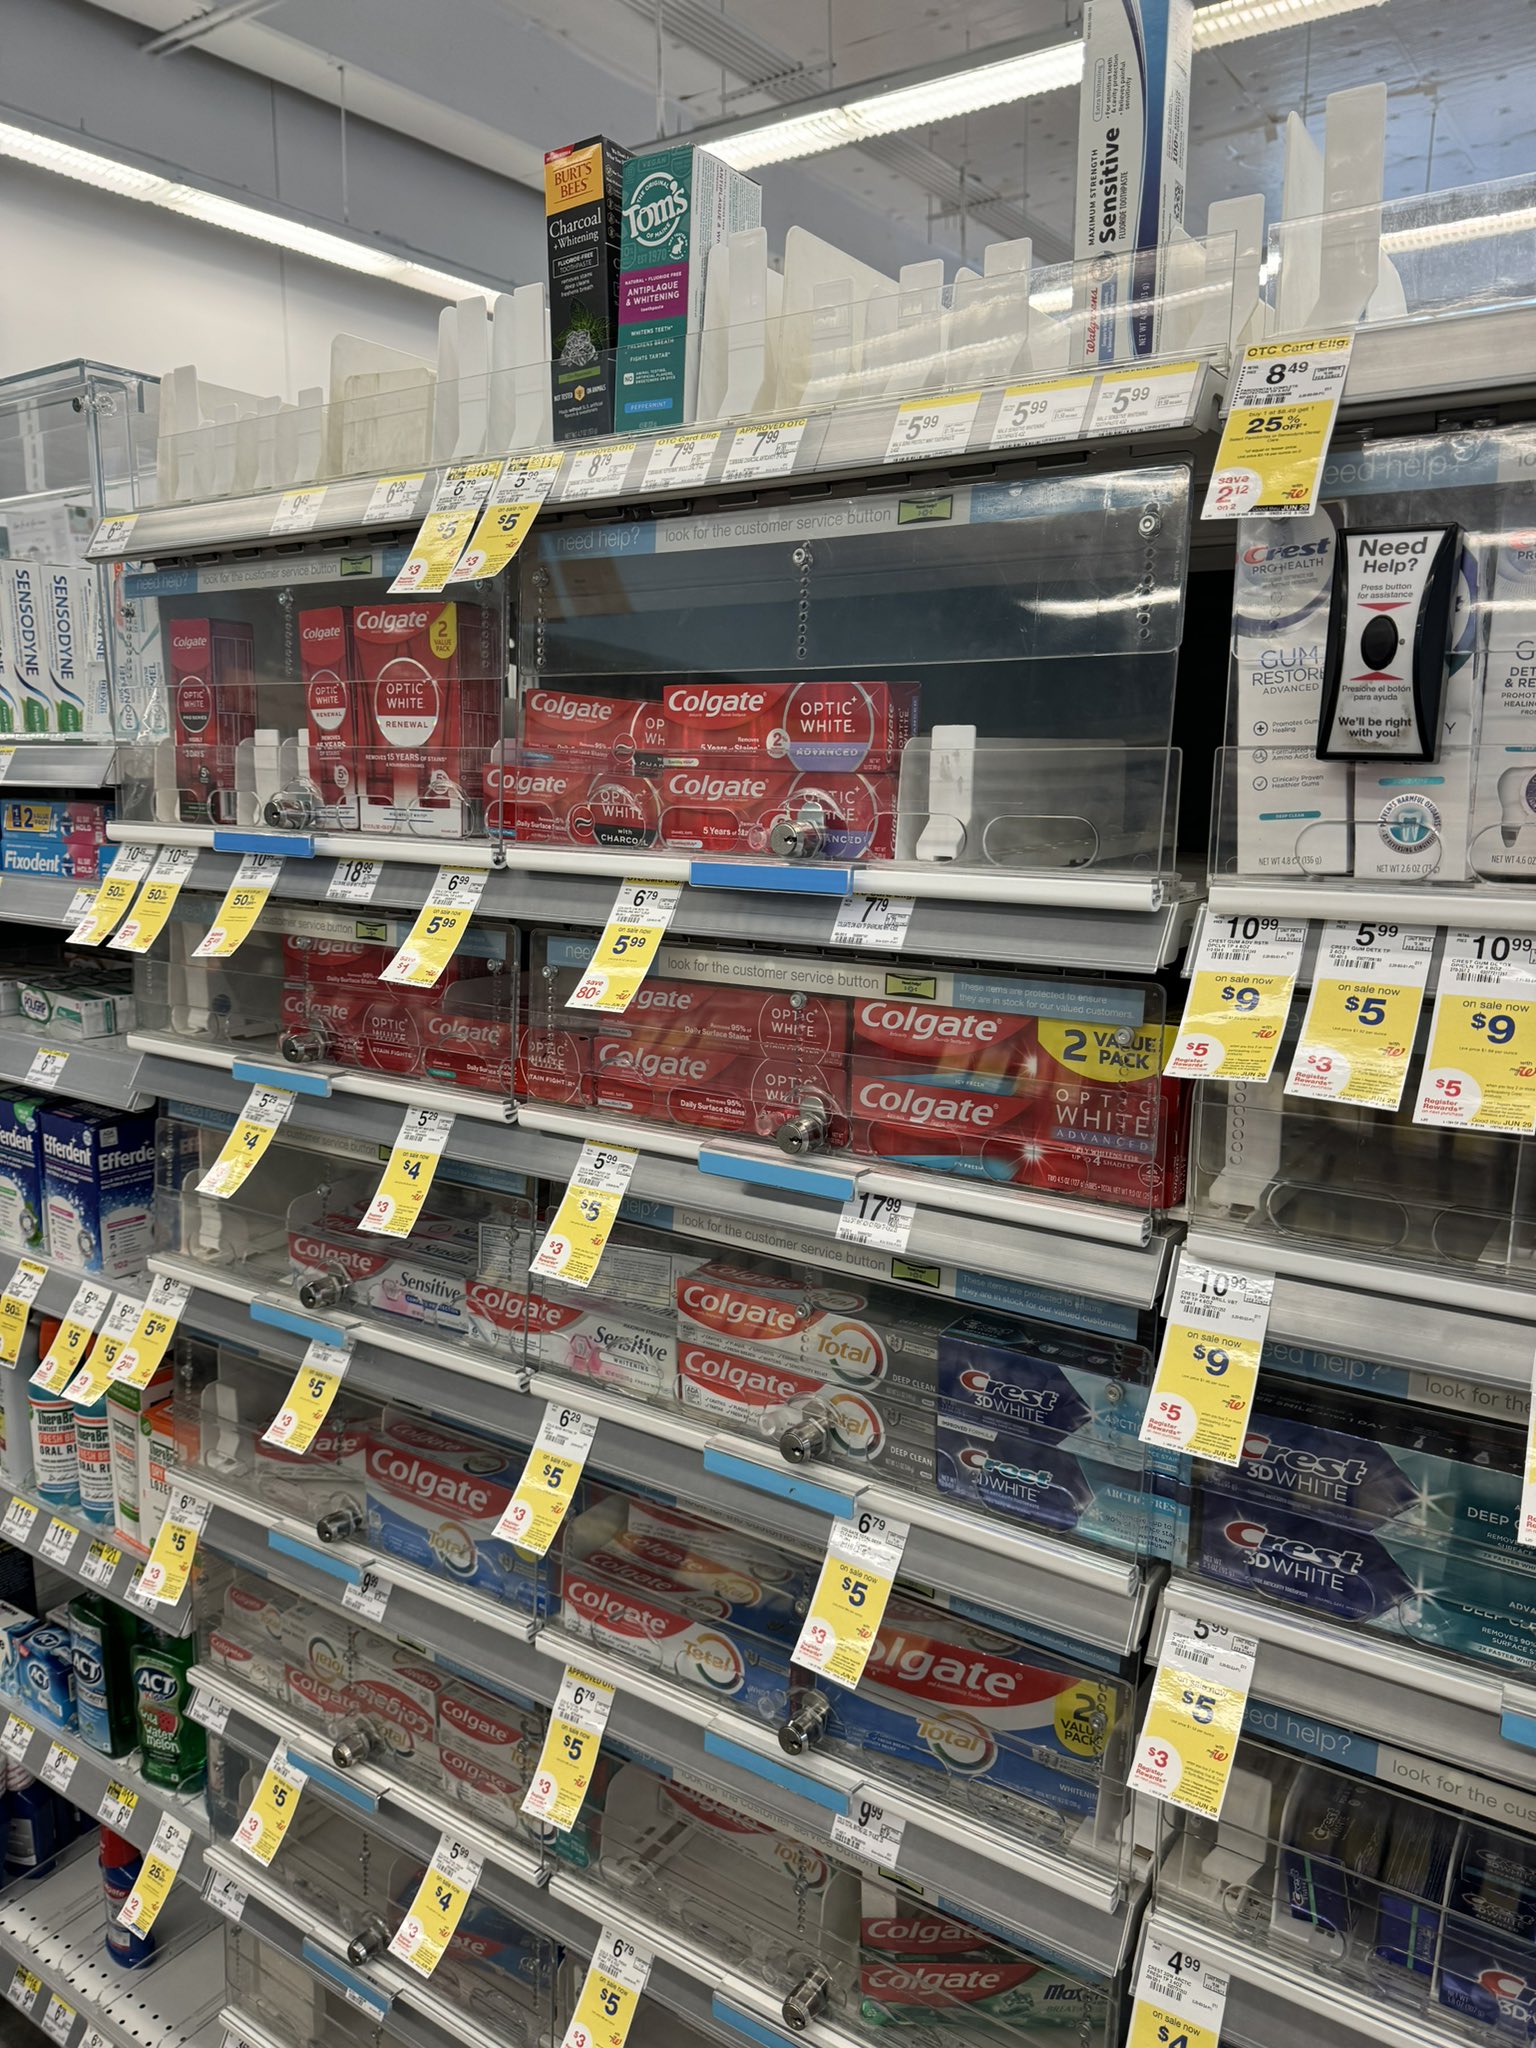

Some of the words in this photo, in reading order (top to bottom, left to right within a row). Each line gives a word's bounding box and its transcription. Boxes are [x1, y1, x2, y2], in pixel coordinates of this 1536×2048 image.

[555, 161, 592, 186] BURT'S
[1099, 127, 1120, 243] Sensitive
[561, 178, 587, 198] BEES
[637, 190, 645, 203] THE
[645, 180, 669, 190] ORIGINAL
[549, 207, 602, 238] Charcoal
[654, 222, 670, 238] MAINE
[1119, 208, 1127, 240] FLUORIDE
[560, 260, 592, 273] TOOTHPASTE
[648, 273, 669, 281] FLUORIDE
[628, 281, 678, 296] ANTIPLAQUE
[634, 291, 679, 304] WHITENING
[1247, 347, 1278, 357] OTC
[1281, 343, 1314, 354] Card
[631, 401, 666, 410] PEPPERMINT
[1218, 476, 1249, 484] save
[665, 529, 690, 542] look
[693, 528, 707, 540] for
[712, 526, 731, 538] the
[734, 519, 792, 538] customer
[796, 514, 843, 531] service
[847, 508, 891, 525] button
[557, 531, 593, 551] need
[598, 526, 640, 550] help?
[1359, 536, 1428, 557] Need
[1243, 538, 1331, 564] Crest
[1363, 558, 1418, 574] Help?
[1357, 591, 1369, 599] for
[1370, 591, 1413, 599] assistance
[1383, 583, 1412, 591] button
[16, 568, 40, 677] SENSODYNE
[53, 574, 74, 680] SENSODYNE
[303, 626, 340, 640] Colgate
[356, 611, 428, 632] Colgate
[437, 620, 448, 638] 2
[173, 636, 207, 648] Colgate
[1261, 646, 1318, 669] GUM
[316, 687, 337, 695] OPTIC
[316, 695, 339, 704] WHITE
[386, 682, 423, 695] OPTIC
[1262, 683, 1319, 695] ADVANCED
[1354, 693, 1371, 701] para
[1373, 693, 1398, 701] ayuda
[387, 698, 424, 709] WHITE
[531, 693, 612, 721] Colgate
[668, 690, 766, 718] Colgate
[800, 701, 852, 715] OPTIC
[1272, 719, 1303, 727] Promotes
[1338, 717, 1366, 726] We'll
[1369, 717, 1382, 726] be
[1385, 717, 1412, 728] right
[1349, 728, 1371, 738] with
[1374, 729, 1400, 738] you!
[669, 774, 768, 802] Colgate
[1272, 781, 1298, 789] Healthier
[4, 850, 59, 874] Fixodent
[1376, 865, 1387, 873] NET
[1389, 865, 1398, 873] WT
[1401, 865, 1411, 873] 2.6
[667, 957, 689, 970] look
[692, 959, 704, 972] for
[709, 962, 729, 974] the
[732, 965, 787, 981] customer
[791, 969, 833, 984] service
[838, 973, 879, 989] button
[959, 983, 984, 992] These
[986, 985, 1007, 995] items
[1009, 988, 1023, 996] are
[1024, 989, 1065, 1001] protected
[1067, 992, 1075, 1000] to
[1078, 995, 1108, 1004] ensure
[1338, 984, 1351, 992] on
[1354, 985, 1375, 994] sale
[1378, 988, 1400, 996] now
[959, 993, 977, 1003] they
[993, 996, 999, 1004] in
[1001, 997, 1024, 1008] stock
[1026, 1000, 1037, 1009] for
[1040, 1002, 1054, 1010] our
[1055, 1002, 1083, 1014] valued
[1344, 995, 1387, 1026] $5
[1462, 1000, 1476, 1008] on
[1480, 1001, 1502, 1010] sale
[1505, 1003, 1529, 1012] now
[861, 1002, 998, 1041] Colgate
[1471, 1012, 1516, 1044] $9
[1063, 1028, 1087, 1062] 2
[599, 1043, 707, 1082] Colgate
[1099, 1051, 1150, 1070] PACK
[1308, 1055, 1332, 1072] $3
[858, 1082, 994, 1126] Colgate
[43, 1133, 92, 1166] Efferdent
[682, 1214, 703, 1227] look
[706, 1219, 719, 1231] for
[725, 1222, 742, 1237] the
[745, 1228, 797, 1250] customer
[800, 1239, 843, 1260] service
[846, 1250, 885, 1271] button
[294, 1236, 372, 1274] Colgate
[401, 1271, 461, 1301] Sensitive
[470, 1284, 563, 1325] Colgate
[683, 1286, 795, 1331] Colgate
[596, 1326, 668, 1363] Sensitive
[817, 1334, 872, 1364] Total
[1187, 1331, 1199, 1339] on
[1201, 1334, 1220, 1344] sale
[1222, 1339, 1242, 1348] now
[685, 1351, 795, 1396] Colgate
[892, 1373, 910, 1384] DEEP
[912, 1379, 936, 1393] CLEAN
[959, 1369, 1059, 1411] Crest
[958, 1448, 1053, 1488] Crest
[1242, 1432, 1368, 1485] Crest
[372, 1449, 490, 1513] Colgate
[1467, 1506, 1509, 1526] DEEP
[1224, 1519, 1364, 1576] Crest
[841, 1577, 868, 1607] $5
[568, 1581, 668, 1635] Colgate
[1482, 1627, 1518, 1643] REMOVES
[442, 1702, 509, 1741] Colgate
[916, 1717, 979, 1753] Total
[1392, 1759, 1430, 1785] look
[1437, 1776, 1464, 1795] for
[1468, 1784, 1497, 1808] the
[868, 1968, 1000, 1991] Colgate
